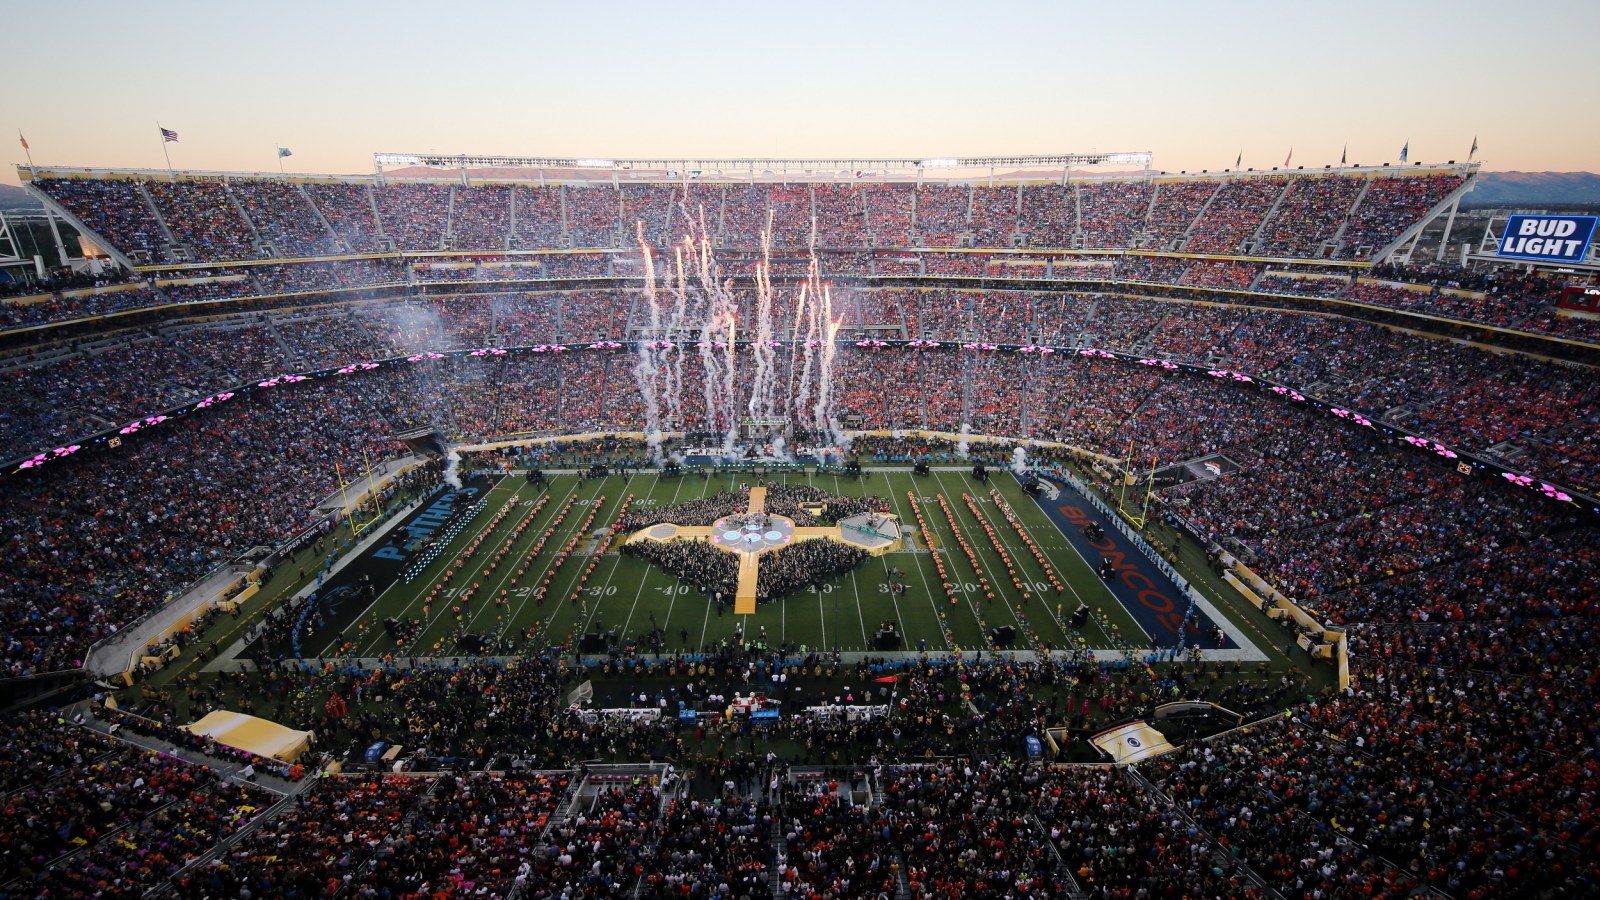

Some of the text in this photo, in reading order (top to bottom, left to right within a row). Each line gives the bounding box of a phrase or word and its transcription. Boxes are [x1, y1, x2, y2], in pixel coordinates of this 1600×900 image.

[1518, 218, 1577, 237] BUD
[1502, 236, 1583, 257] LIGHT
[280, 539, 301, 557] SUPER
[589, 585, 618, 596] 30
[662, 585, 690, 596] 40
[952, 582, 977, 593] 20
[1022, 582, 1049, 592] 10
